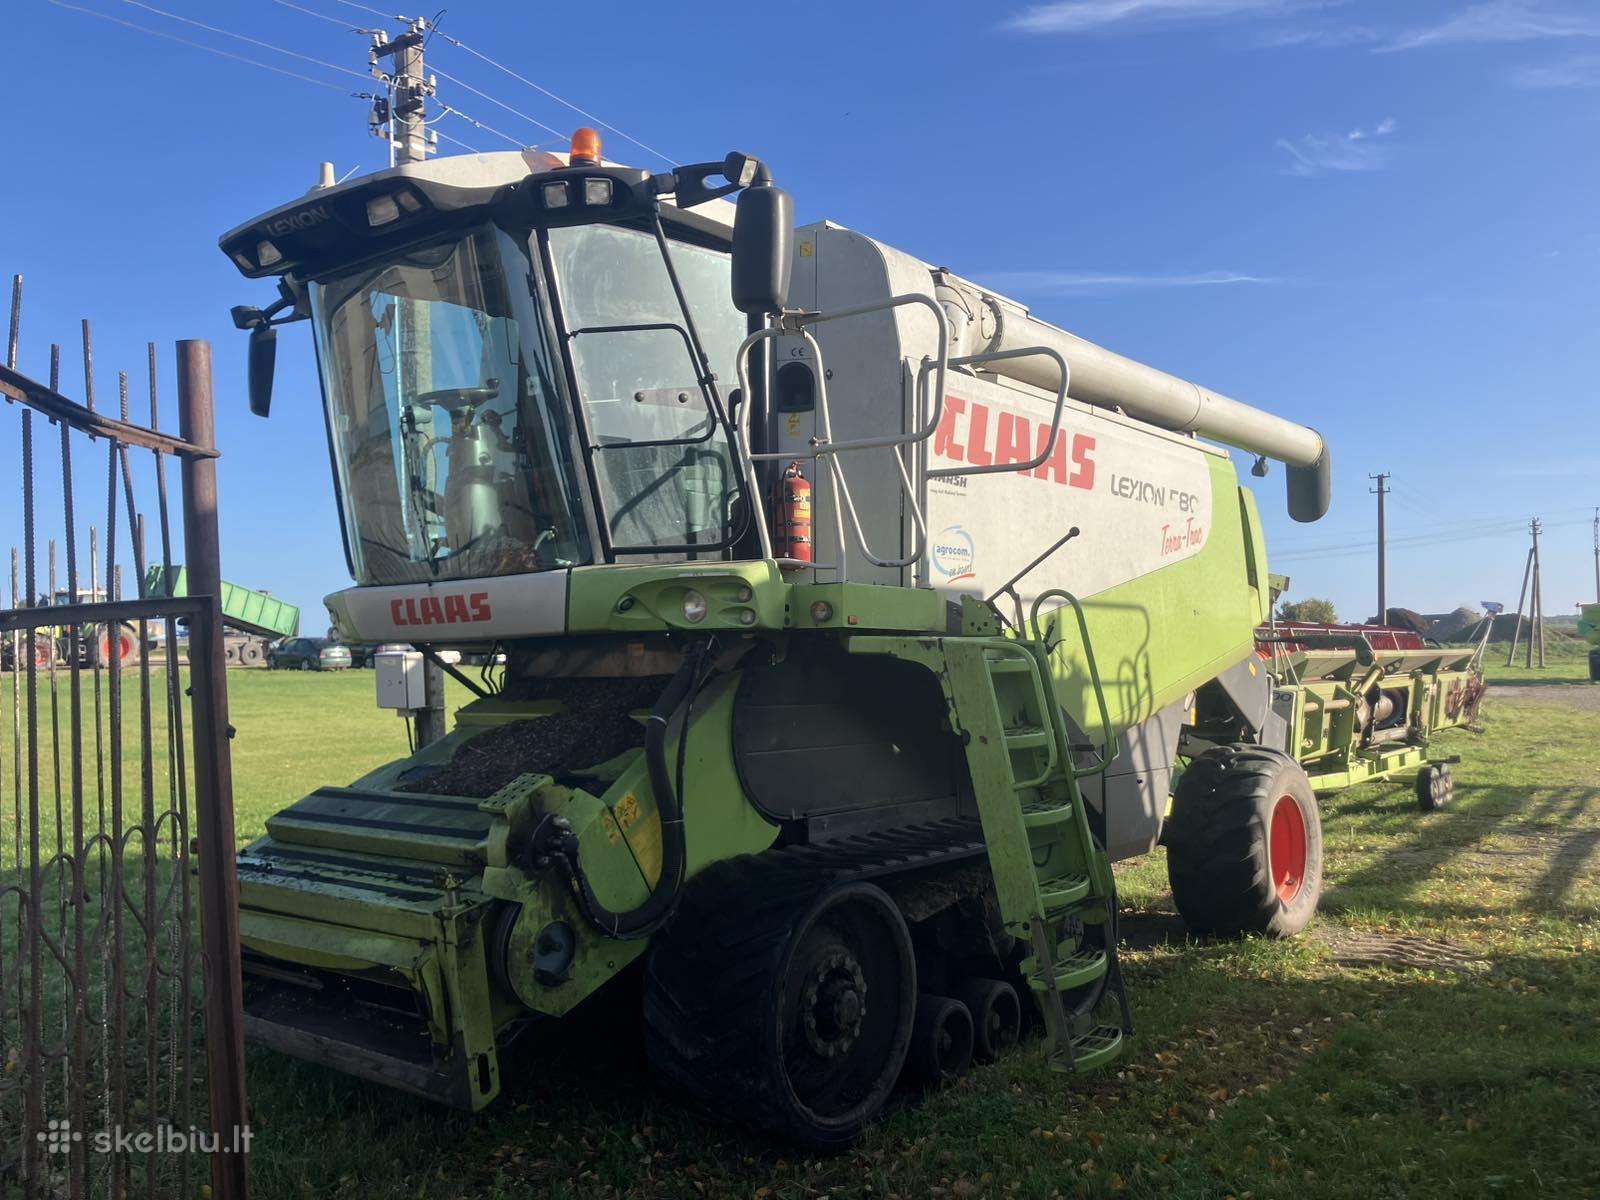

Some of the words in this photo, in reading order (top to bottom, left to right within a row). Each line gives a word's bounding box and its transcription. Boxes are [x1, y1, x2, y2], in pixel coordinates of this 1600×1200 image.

[266, 206, 331, 237] LEXION
[934, 395, 1096, 490] CLAAS
[1111, 474, 1165, 506] LEXION
[391, 592, 492, 626] CLAAS
